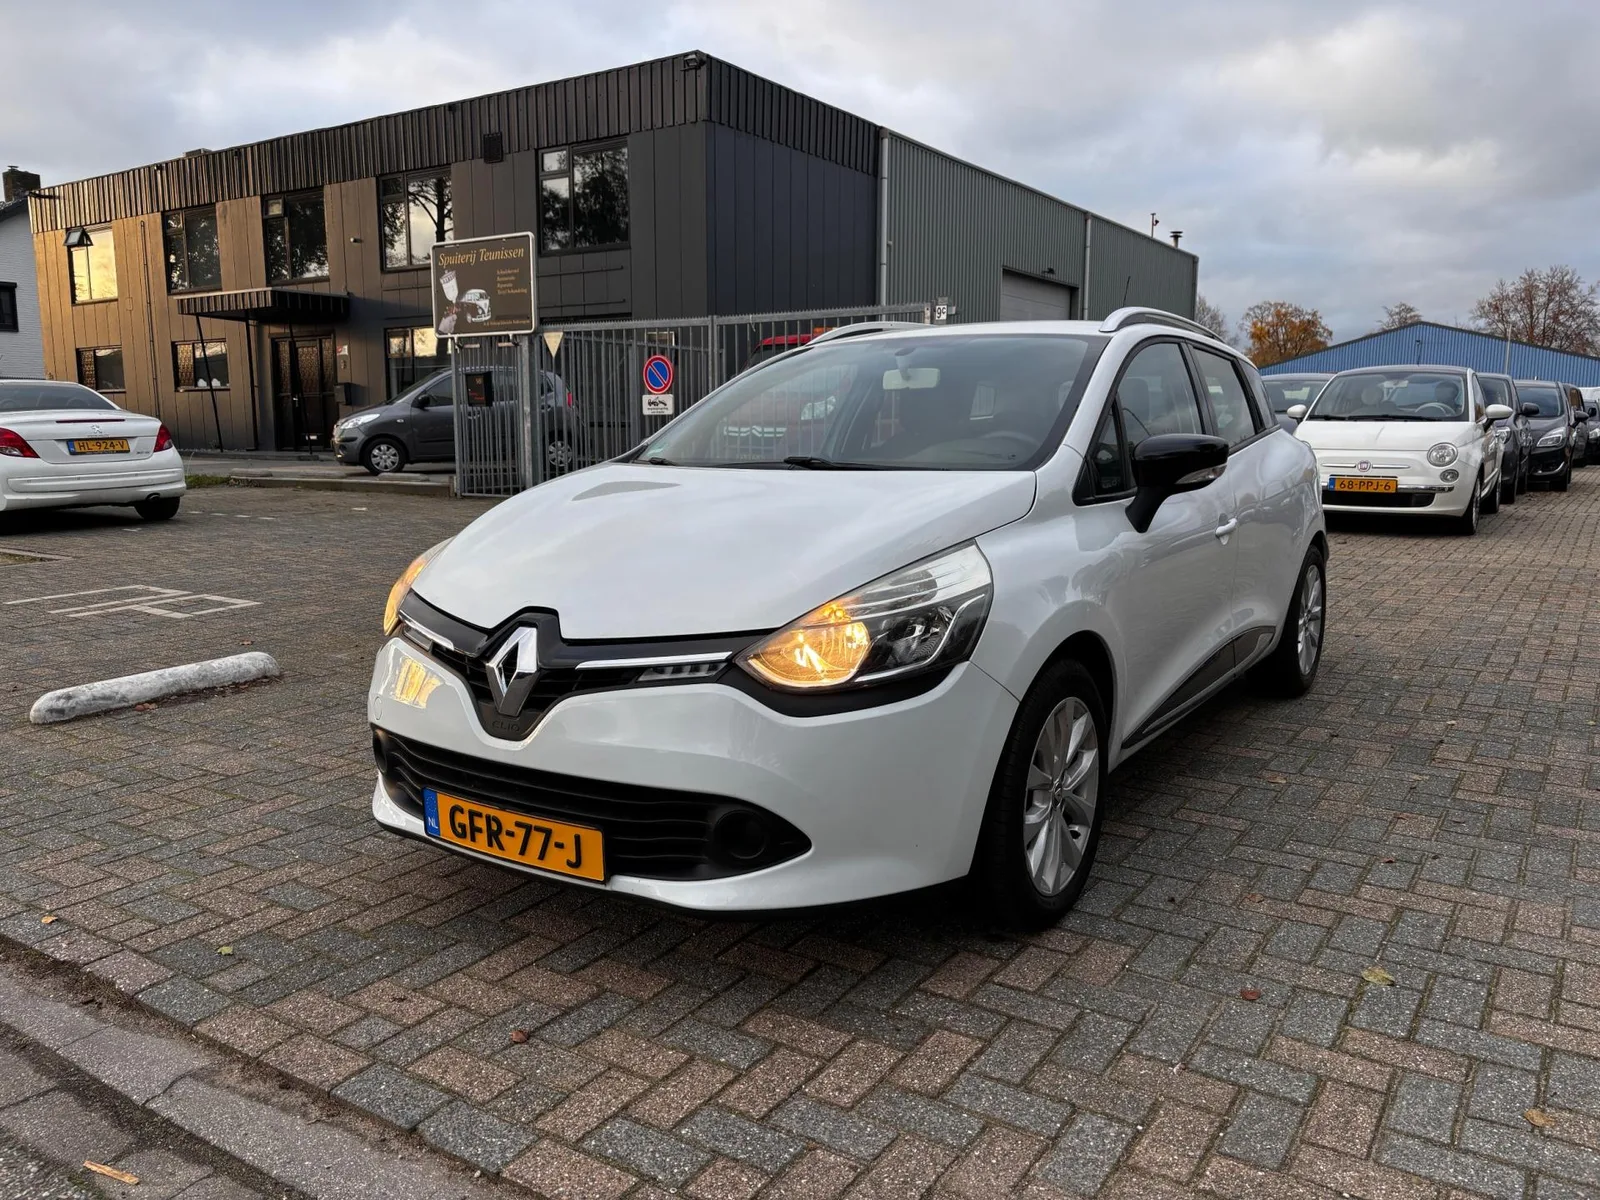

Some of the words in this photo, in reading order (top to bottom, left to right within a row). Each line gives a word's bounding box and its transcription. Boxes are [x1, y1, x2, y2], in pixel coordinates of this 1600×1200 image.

[438, 251, 477, 268] Spuiterij
[479, 247, 524, 262] Teunissen
[78, 440, 125, 451] HL-924-V
[1339, 480, 1391, 491] 68-PPJ-6
[428, 817, 439, 828] NL
[449, 805, 582, 868] GFR-77-J
